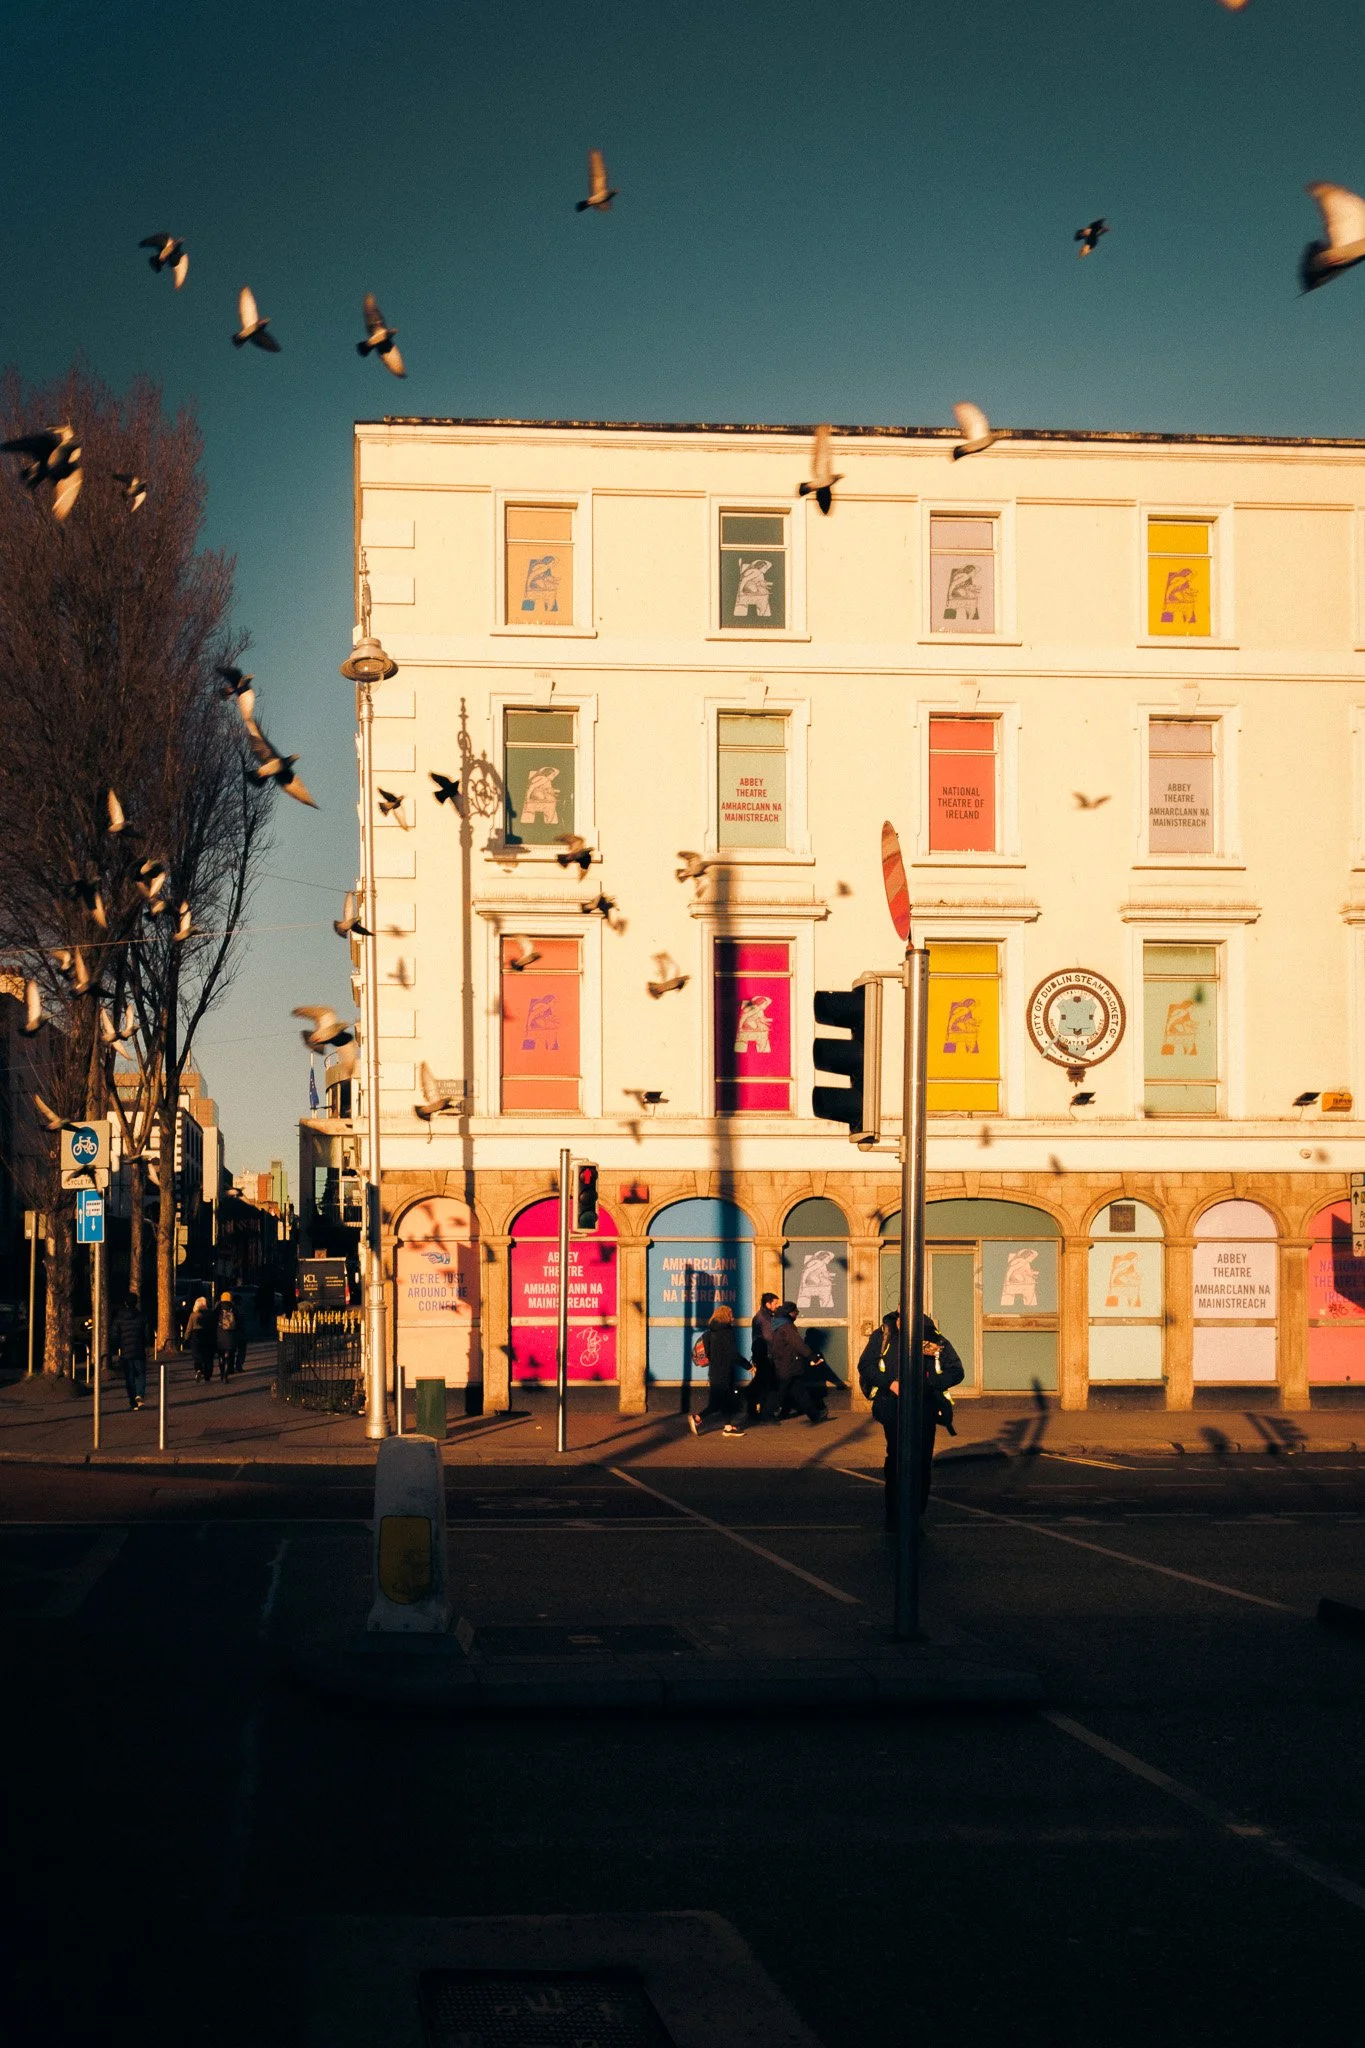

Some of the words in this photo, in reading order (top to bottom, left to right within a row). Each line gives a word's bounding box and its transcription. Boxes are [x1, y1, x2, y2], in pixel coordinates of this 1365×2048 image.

[739, 777, 764, 787] ABBEY
[1167, 783, 1192, 792] ABBEY
[735, 788, 768, 798] THEATRE
[942, 786, 980, 796] NATIONAL
[938, 798, 972, 808] THEATRE
[974, 798, 985, 808] OF
[1164, 794, 1195, 803] THEATRE
[721, 802, 771, 811] AMHARCLANN
[772, 802, 782, 811] NA
[1149, 807, 1198, 816] AMHARCLANN
[1200, 807, 1210, 816] NA
[724, 813, 779, 822] MAINISTREACH
[945, 809, 980, 819] IRELAND
[1152, 818, 1207, 827] MAINISTREACH
[1074, 974, 1105, 992] STEAM
[1034, 998, 1044, 1011] OF
[1033, 1014, 1043, 1036] CITY
[547, 1251, 579, 1263] ABEY
[1217, 1253, 1247, 1264] ABBEY
[543, 1265, 584, 1277] THETRE
[1213, 1267, 1252, 1278] THEATRE
[410, 1273, 440, 1284] WE'RE
[443, 1272, 465, 1284] JUST
[407, 1286, 447, 1298] AROUND
[450, 1286, 468, 1298] THE
[523, 1283, 588, 1295] AMHARANN
[589, 1283, 603, 1295] NA
[1194, 1284, 1256, 1295] AMHARCLANN
[1258, 1284, 1271, 1295] NA
[663, 1289, 678, 1303] NA
[418, 1300, 457, 1311] CORNER
[527, 1297, 599, 1309] MAINISREACH
[1198, 1298, 1266, 1309] MAINISTREACH
